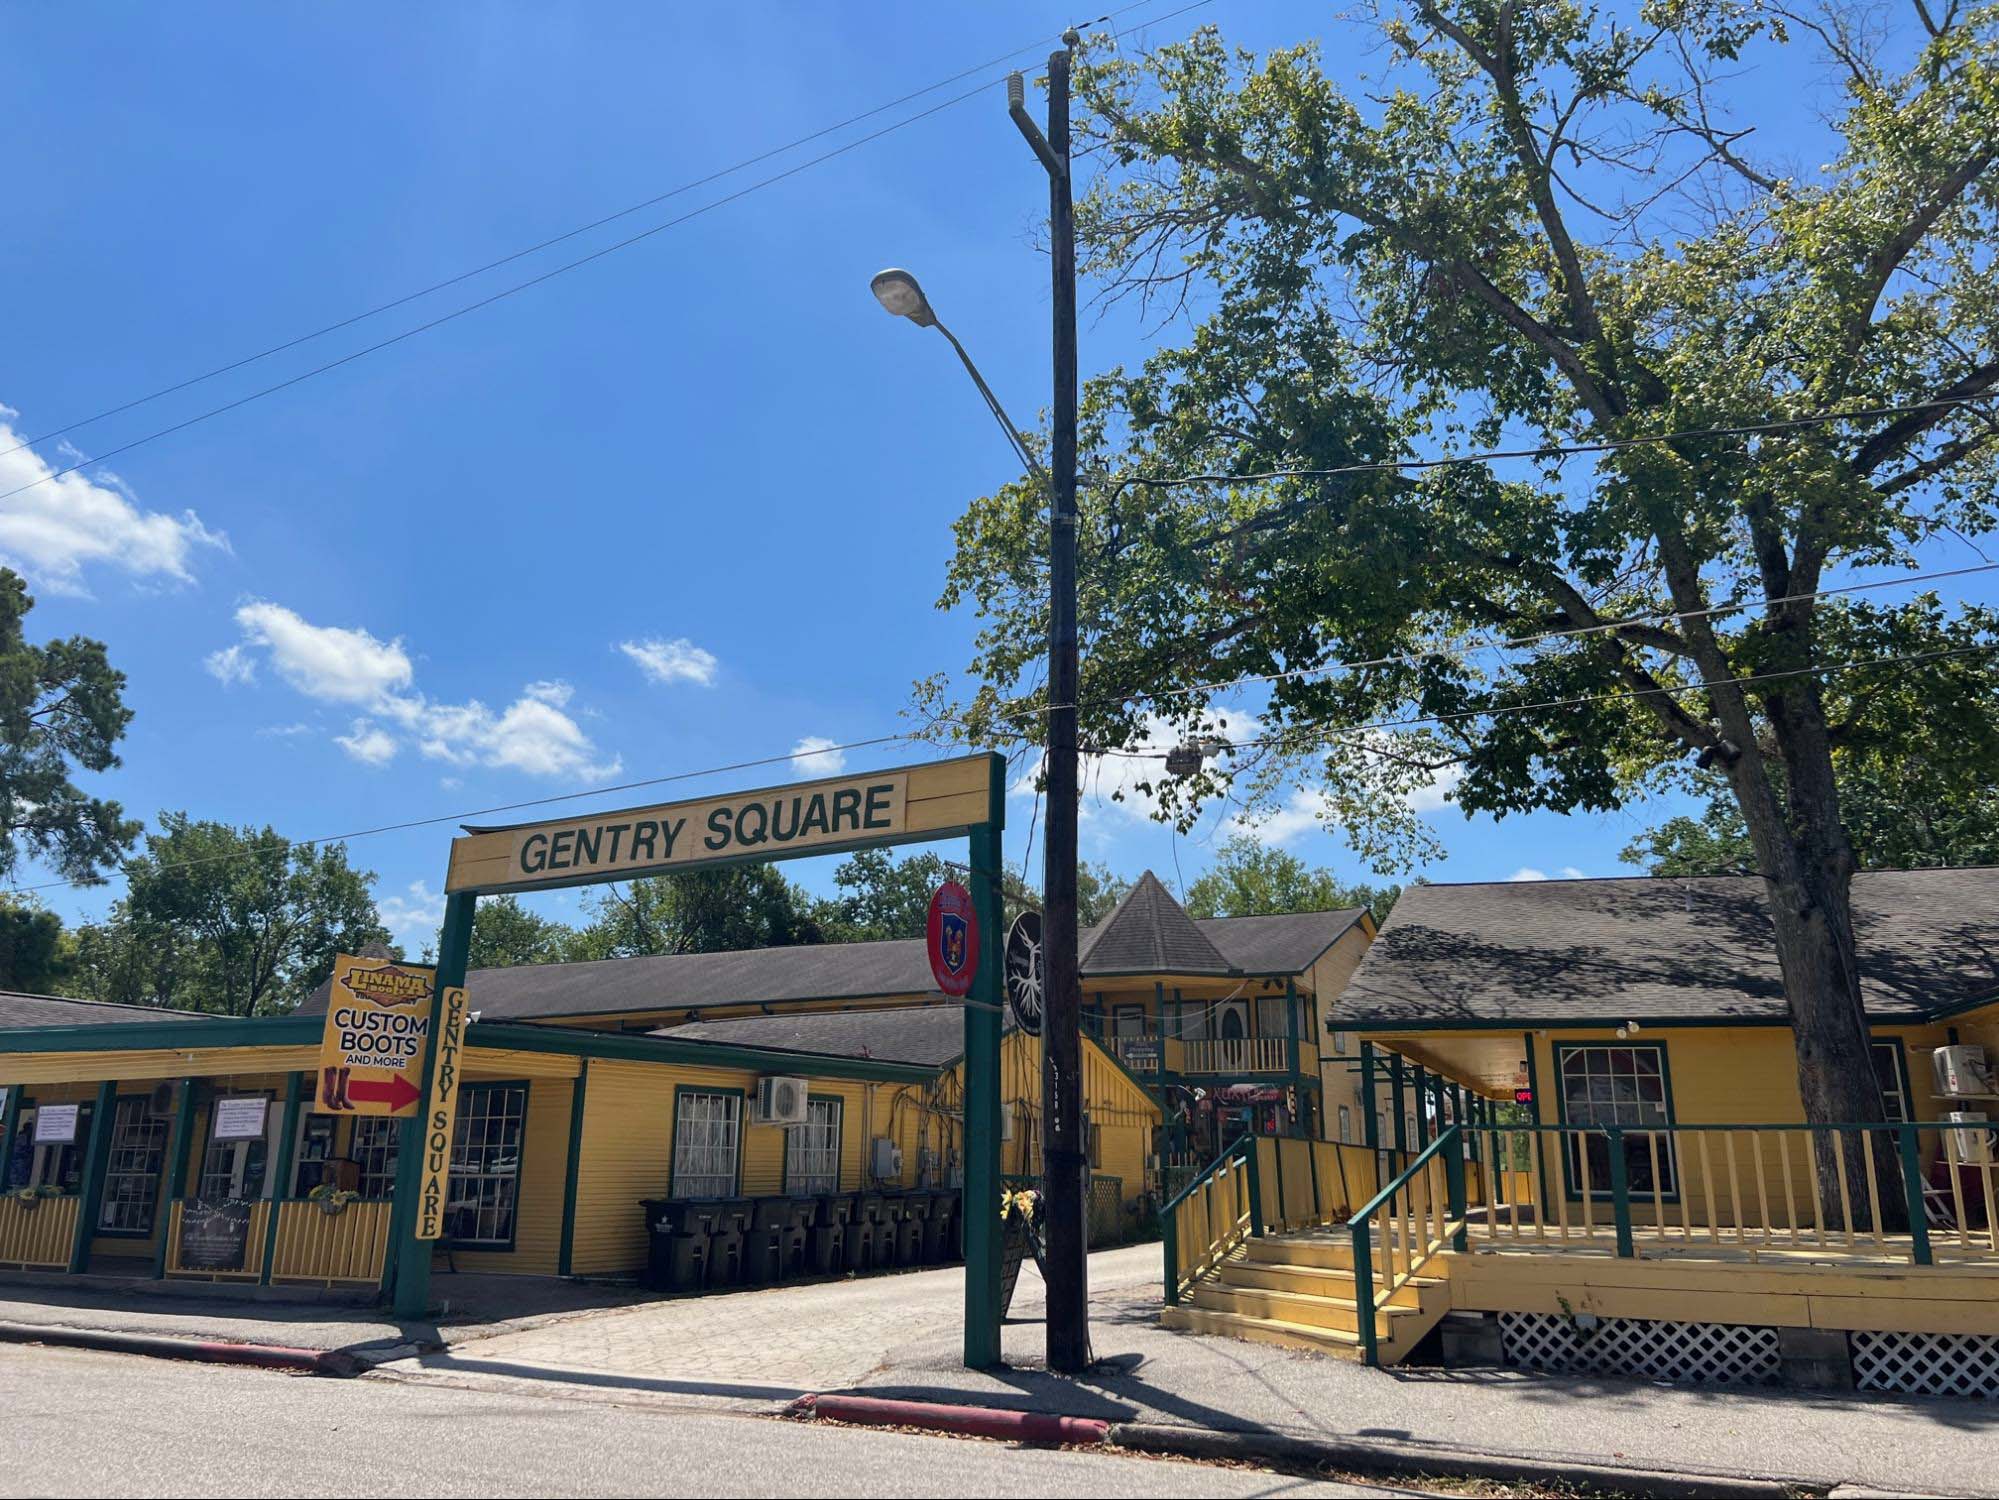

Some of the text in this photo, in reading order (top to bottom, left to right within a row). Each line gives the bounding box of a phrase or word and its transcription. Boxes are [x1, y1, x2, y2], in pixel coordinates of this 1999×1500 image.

[520, 784, 894, 874] GENTRY SQUARE
[335, 1008, 428, 1035] CUSTOM
[341, 1032, 417, 1056] BOOTS
[345, 1054, 405, 1068] AND MORE
[421, 991, 463, 1237] GENTRY SQUARE
